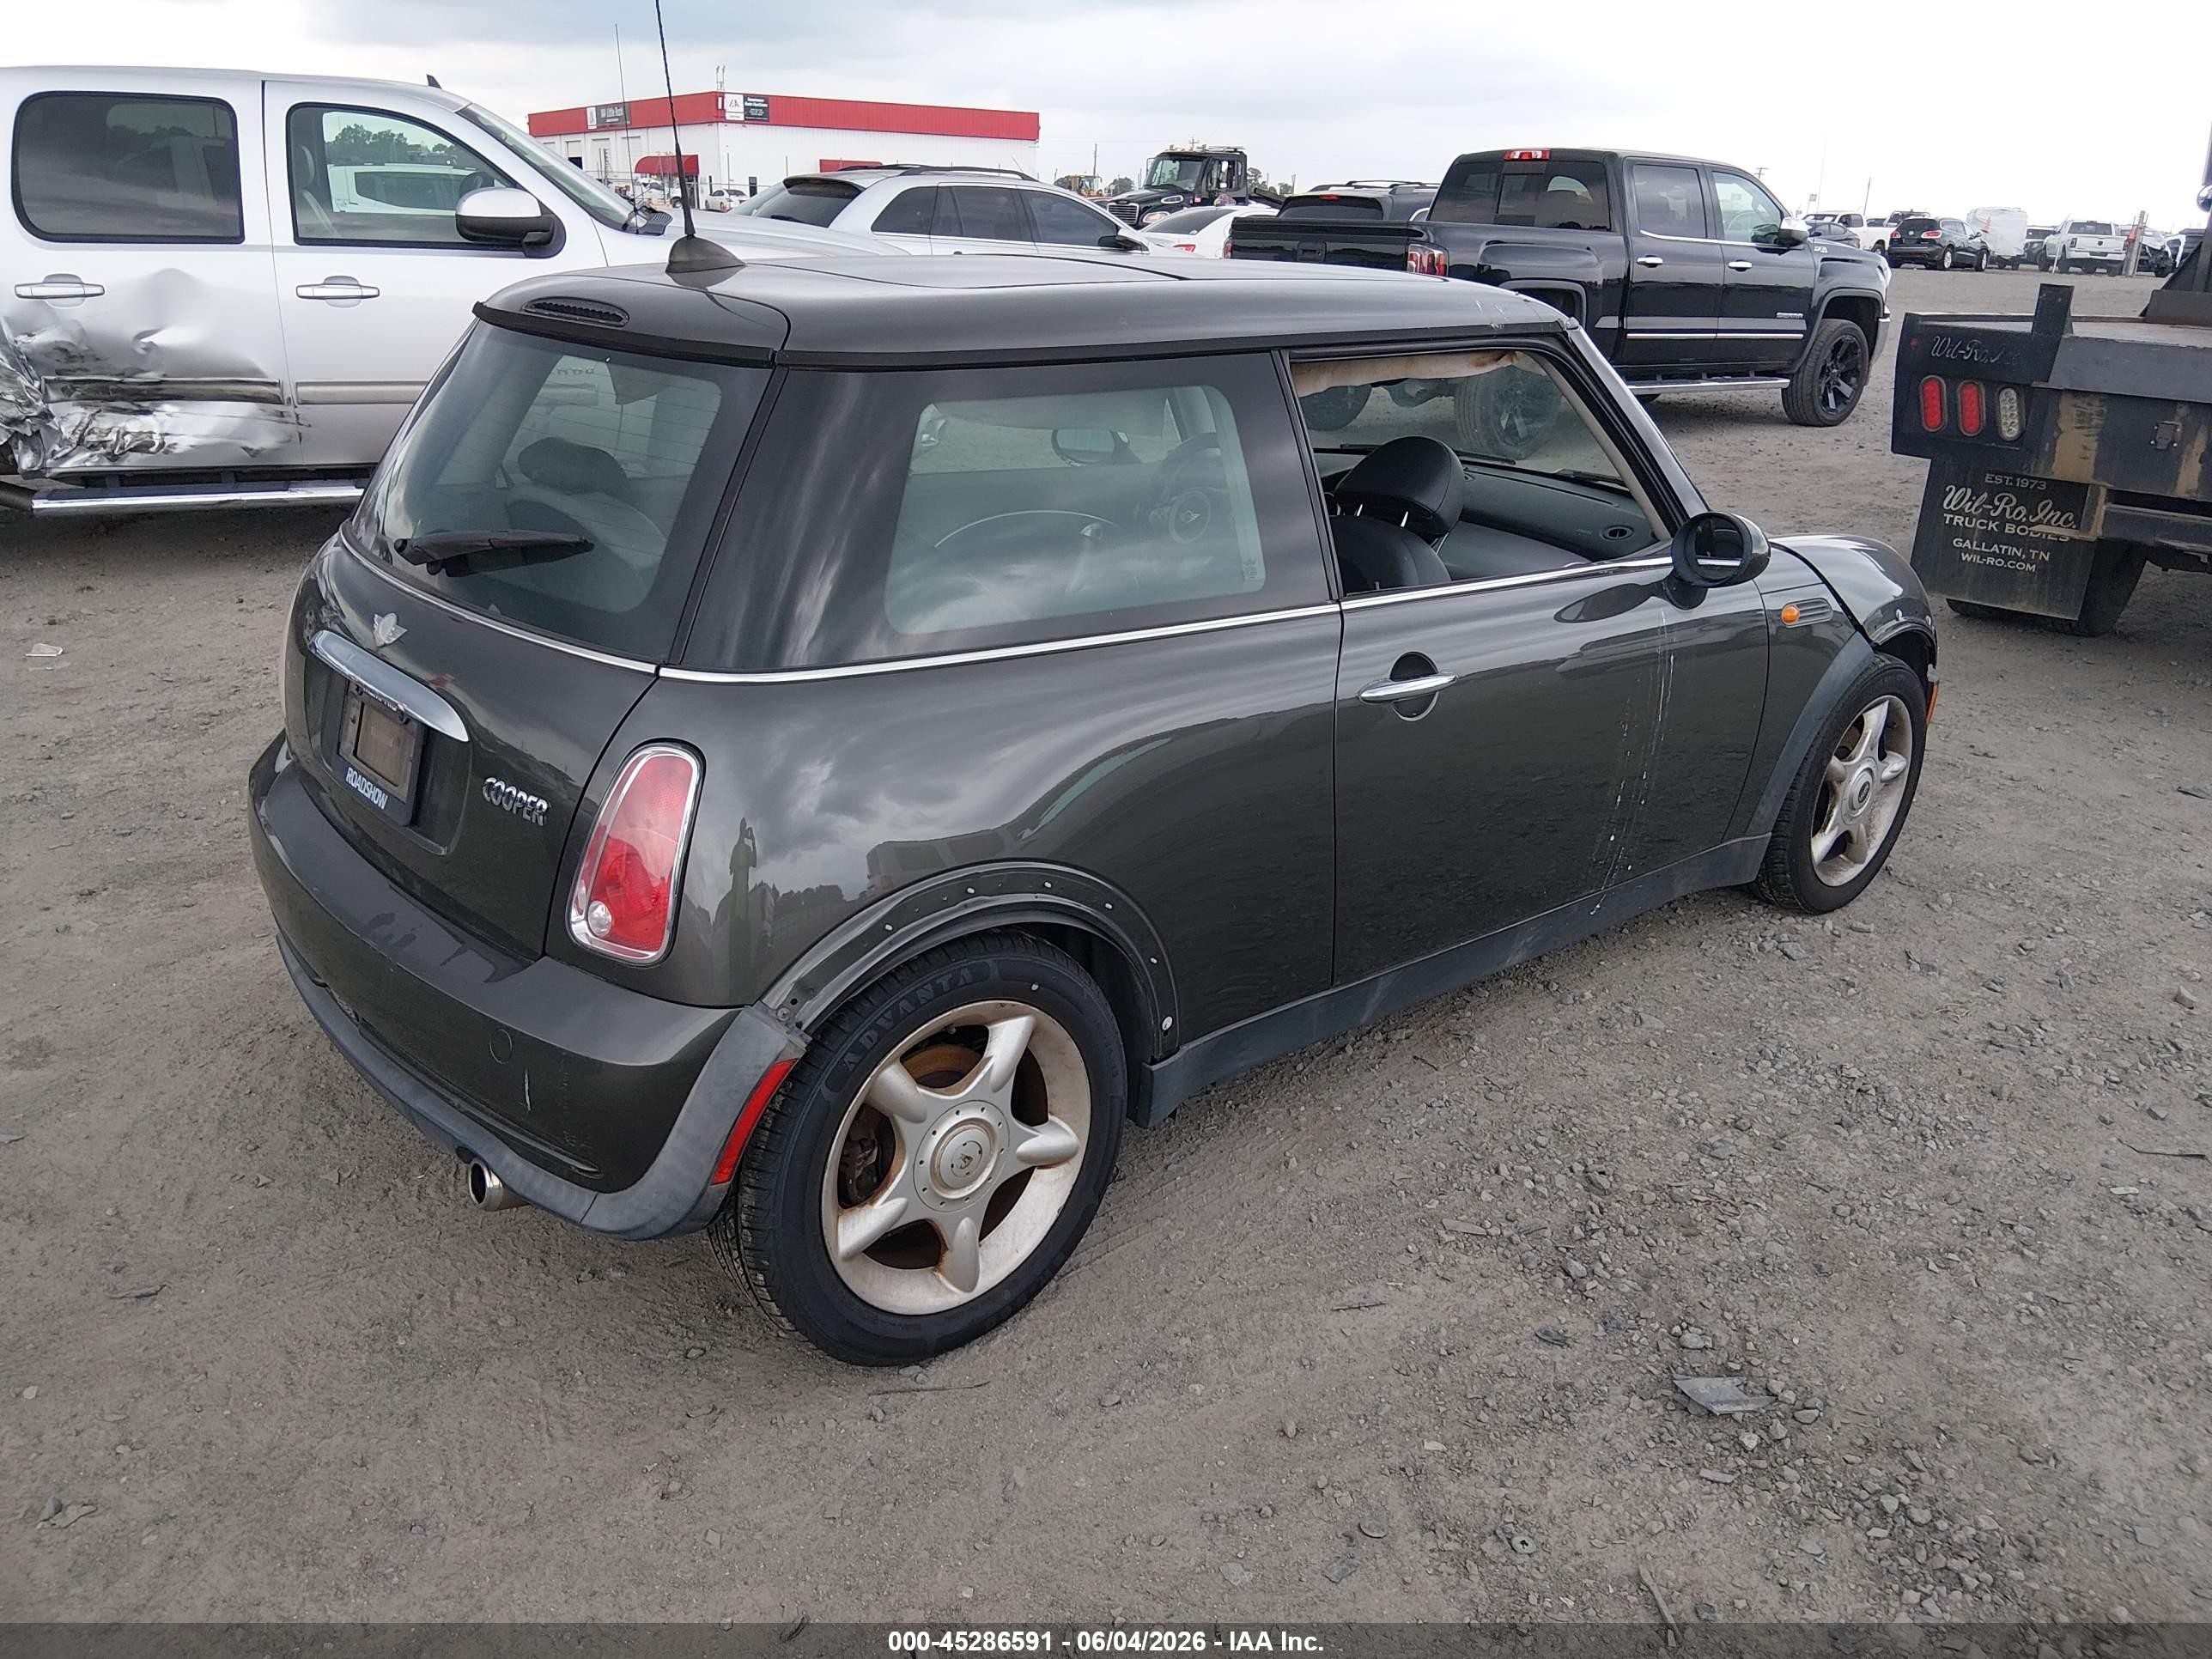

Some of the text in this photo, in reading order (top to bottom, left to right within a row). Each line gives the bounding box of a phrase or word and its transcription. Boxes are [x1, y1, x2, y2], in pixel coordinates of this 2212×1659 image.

[1984, 473, 2047, 490] EST. 1973
[1943, 513, 2000, 532] TRUCK
[2028, 499, 2077, 529] Inc.
[1953, 538, 2051, 561] GALLATIN, TN
[1960, 552, 2036, 572] WIL-RO.COM
[345, 767, 388, 810] ROADSHOW
[482, 777, 548, 826] COOPER
[843, 968, 973, 1072] ADVANTA
